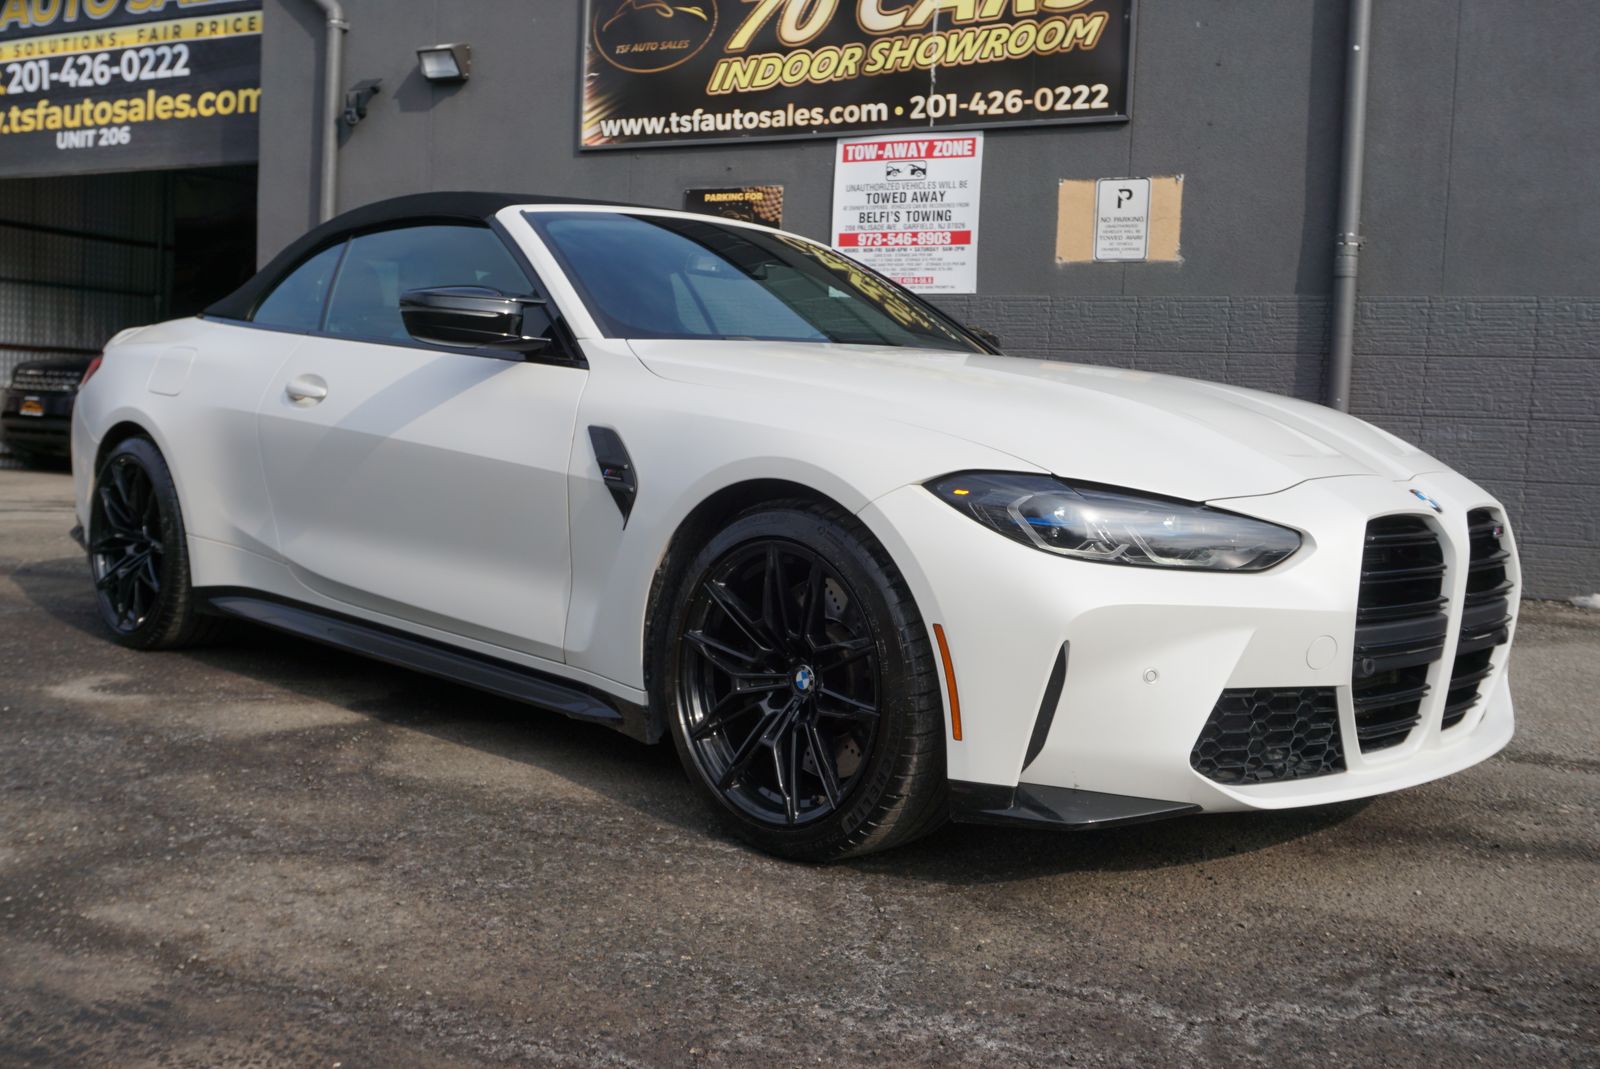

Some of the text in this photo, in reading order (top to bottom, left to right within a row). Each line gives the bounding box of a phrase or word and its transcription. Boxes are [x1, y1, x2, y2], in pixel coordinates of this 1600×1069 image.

[136, 24, 182, 42] FAIR
[195, 16, 257, 37] PRICE
[631, 41, 658, 53] AUTO
[660, 39, 690, 51] SALES
[706, 11, 1109, 95] INDOOR SHOWROOM
[6, 43, 191, 95] 201-426-0222
[600, 83, 1109, 137] www.tsfautosales.com 201-426-0222
[56, 126, 131, 150] UNIT 206
[846, 139, 973, 161] TOW-AWAY ZONE
[846, 179, 968, 193] UNAUTHORIZED VEHICLES WILL BE
[704, 192, 763, 201] PARKING FOR
[866, 190, 947, 205] TOWED AWAY
[858, 209, 953, 224] BELFI'S TOWING
[857, 232, 952, 246] 973-546-8903
